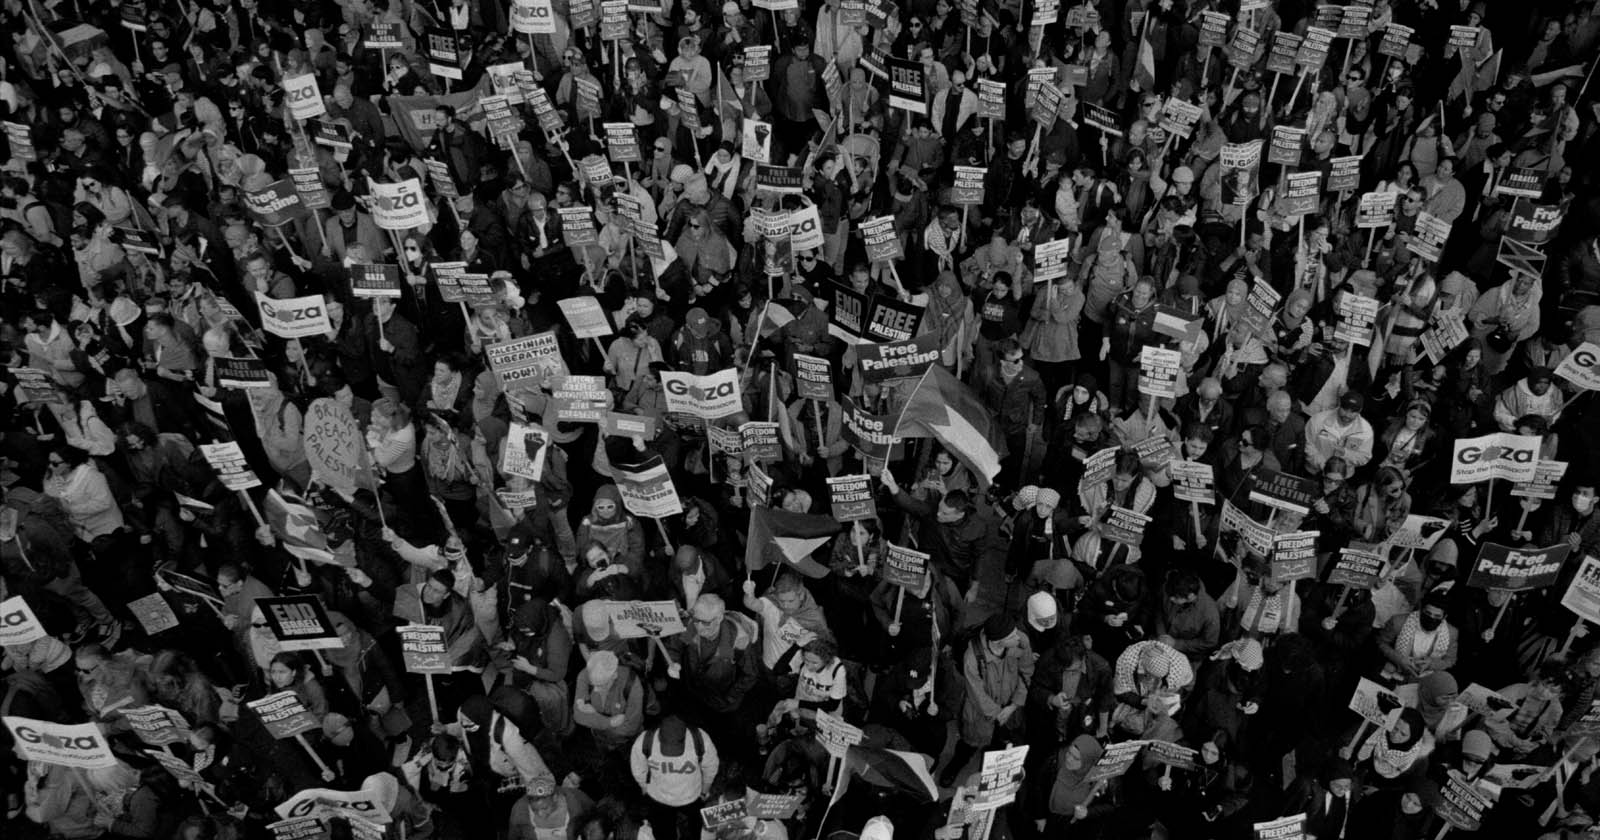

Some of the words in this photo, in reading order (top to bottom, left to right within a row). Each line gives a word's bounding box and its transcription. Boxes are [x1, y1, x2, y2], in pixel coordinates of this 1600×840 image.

[428, 33, 456, 52] FREE
[891, 65, 920, 86] FREE
[891, 80, 922, 96] PALESTINE
[1223, 158, 1235, 166] IN
[757, 174, 802, 185] PALESTINE
[768, 168, 789, 177] FREE
[1509, 173, 1538, 183] ISRAELI
[954, 179, 984, 189] PALESTINE
[862, 221, 894, 236] FREEDOM
[1512, 215, 1563, 231] Pales
[864, 231, 897, 246] PALESTINE
[260, 301, 322, 321] Gza
[835, 290, 862, 316] END
[1247, 293, 1273, 321] PALESTINE
[873, 304, 917, 333] FREE
[869, 321, 912, 341] PALESTINE
[489, 336, 553, 357] PALESTINIAN
[493, 344, 557, 366] LIBERATION
[878, 343, 918, 358] Free
[797, 359, 830, 373] FREEDOM
[861, 349, 940, 371] Palestine
[502, 366, 537, 382] NOW!
[797, 369, 831, 384] PALESTINE
[666, 379, 734, 401] Gza
[669, 396, 685, 406] Stop
[699, 398, 738, 410] massacre
[315, 404, 354, 436] BRING
[853, 407, 884, 431] Free
[743, 427, 777, 439] FREEDOM
[842, 411, 903, 446] Palestine
[333, 439, 343, 457] 2
[743, 436, 780, 450] PALESTINE
[1457, 446, 1534, 464] Gza
[1456, 467, 1476, 477] Stop
[1476, 466, 1490, 476] the
[1490, 464, 1531, 474] massacre
[831, 481, 868, 492] FREEDOM
[1273, 474, 1302, 489] FREE
[831, 491, 872, 503] PALESTINE
[1254, 478, 1313, 504] PALESTINE
[1106, 517, 1145, 534] PALESTINE
[1111, 511, 1147, 526] FREEDOM
[1224, 517, 1236, 528] IN
[1239, 528, 1266, 555] AZA
[1276, 538, 1316, 551] FREEDOM
[887, 549, 925, 564] FREEDOM
[1275, 549, 1316, 561] PALESTINE
[1340, 553, 1381, 568] FREEDOM
[1506, 550, 1548, 567] Free
[886, 557, 926, 575] PALESTINE
[1335, 561, 1380, 577] PALESTINE
[1477, 558, 1562, 578] Palestine
[269, 603, 317, 622] END
[403, 631, 441, 642] FREEDOM
[403, 642, 446, 653] PALESTINE
[255, 694, 298, 714] FREEDOM
[259, 704, 308, 723] PALESTINE
[15, 726, 99, 750] Gza
[1447, 778, 1486, 812] FREEDOM
[289, 799, 376, 817] Gza
[1440, 787, 1483, 823] PALESTINE
[276, 819, 319, 832] FREEDOM
[1259, 821, 1302, 840] FREEDOM
